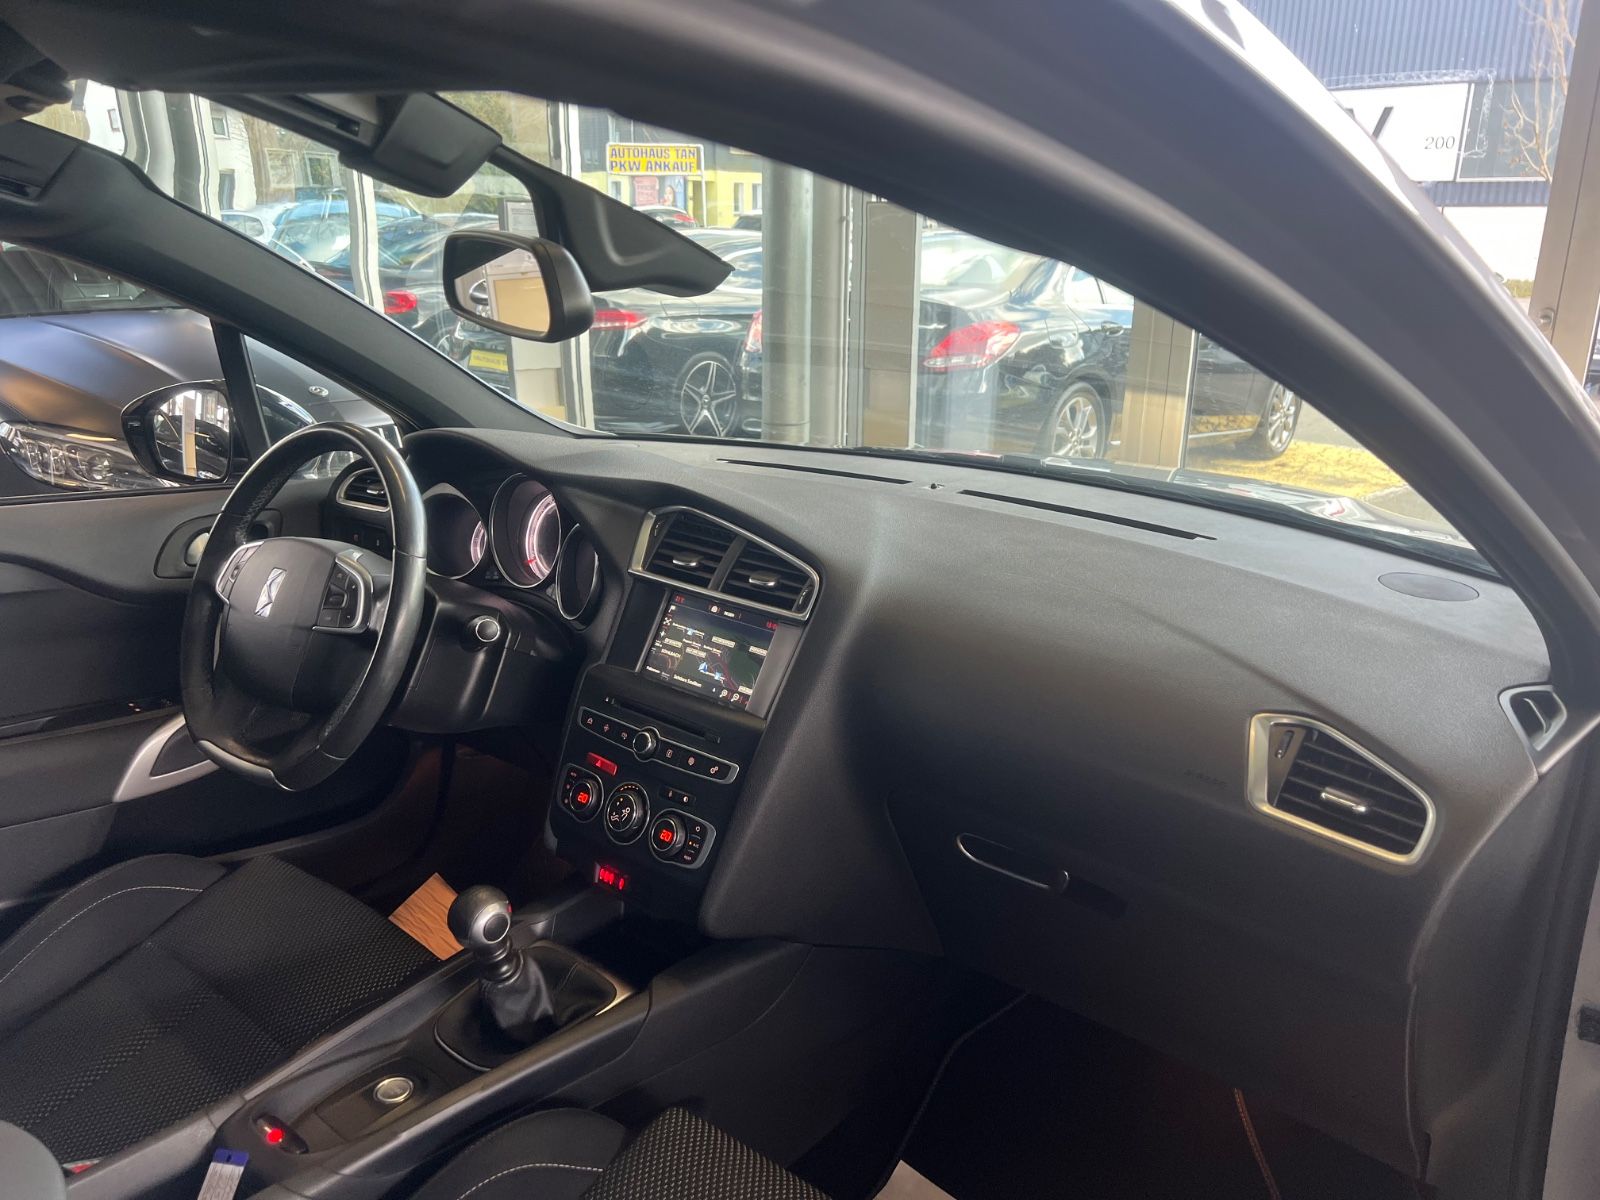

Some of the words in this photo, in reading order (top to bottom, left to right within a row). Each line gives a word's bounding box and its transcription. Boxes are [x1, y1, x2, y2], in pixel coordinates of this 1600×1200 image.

[1424, 136, 1455, 150] 200
[611, 147, 670, 159] AUTOHAUS
[675, 148, 696, 160] TAN
[610, 160, 641, 172] PKW
[646, 160, 695, 173] ANKAUF
[577, 792, 589, 804] 20
[660, 829, 673, 842] 20
